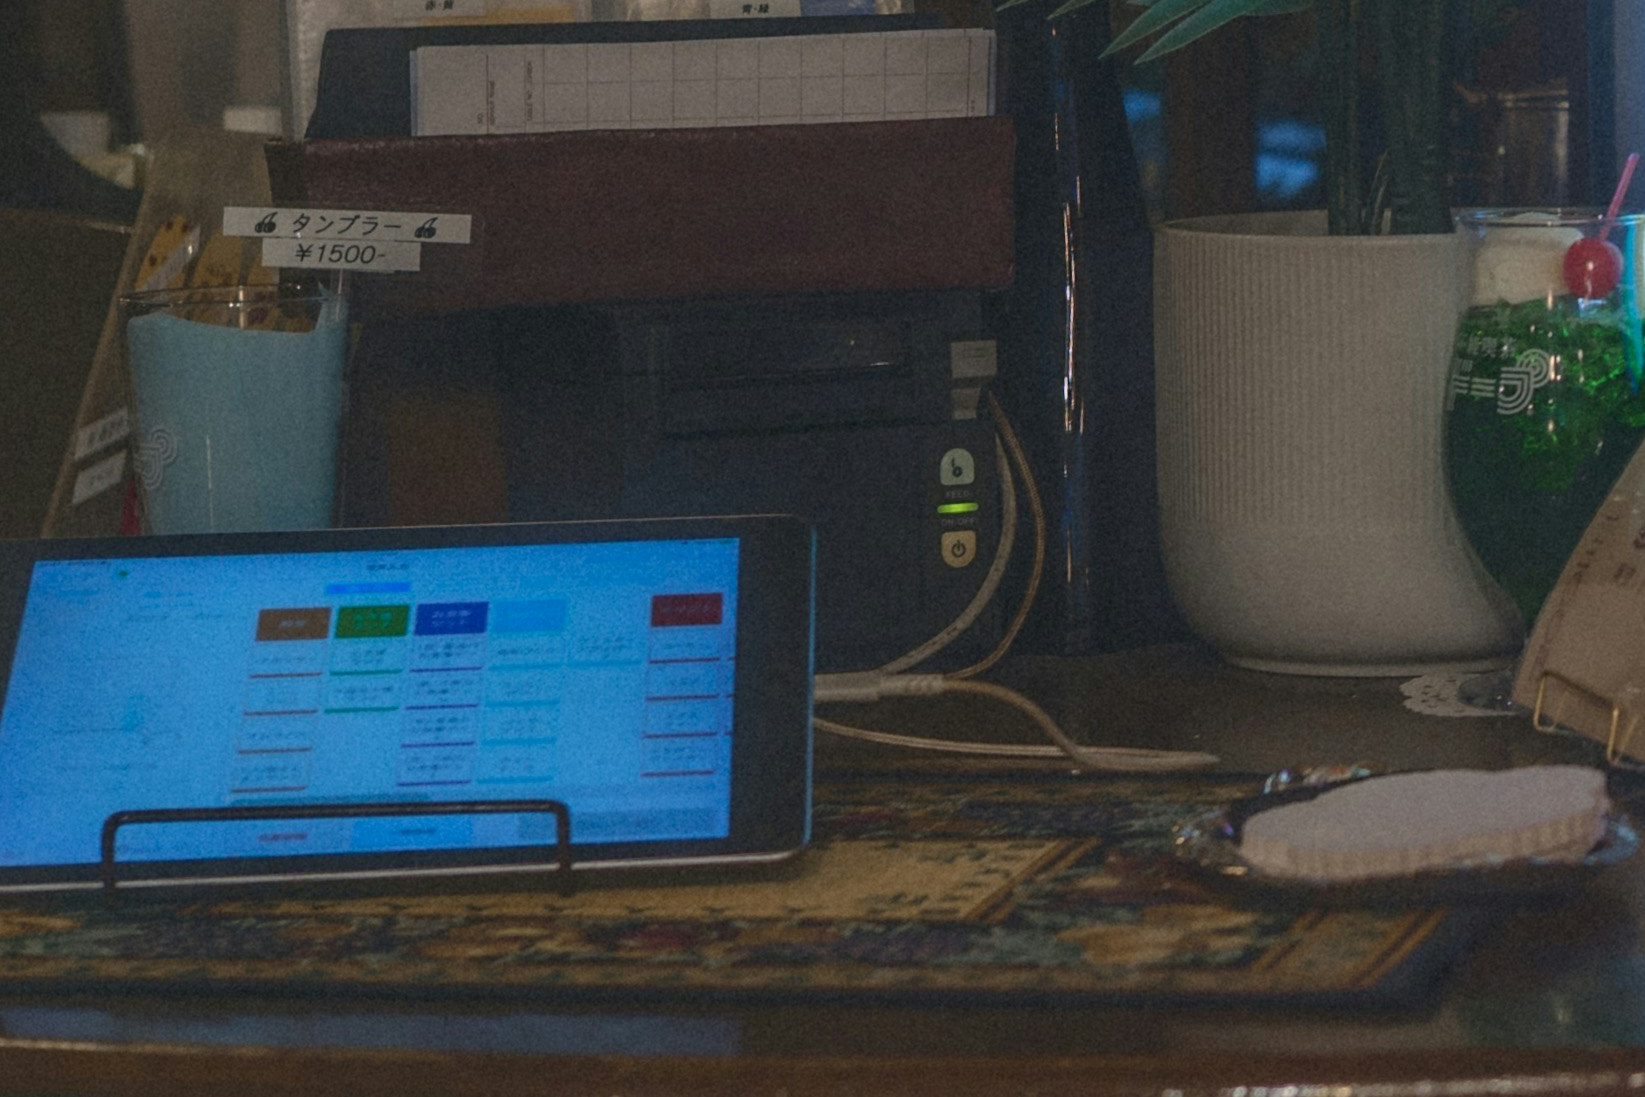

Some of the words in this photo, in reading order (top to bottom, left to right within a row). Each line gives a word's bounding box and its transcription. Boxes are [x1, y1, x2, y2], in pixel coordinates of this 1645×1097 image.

[293, 213, 401, 235] タンブラー
